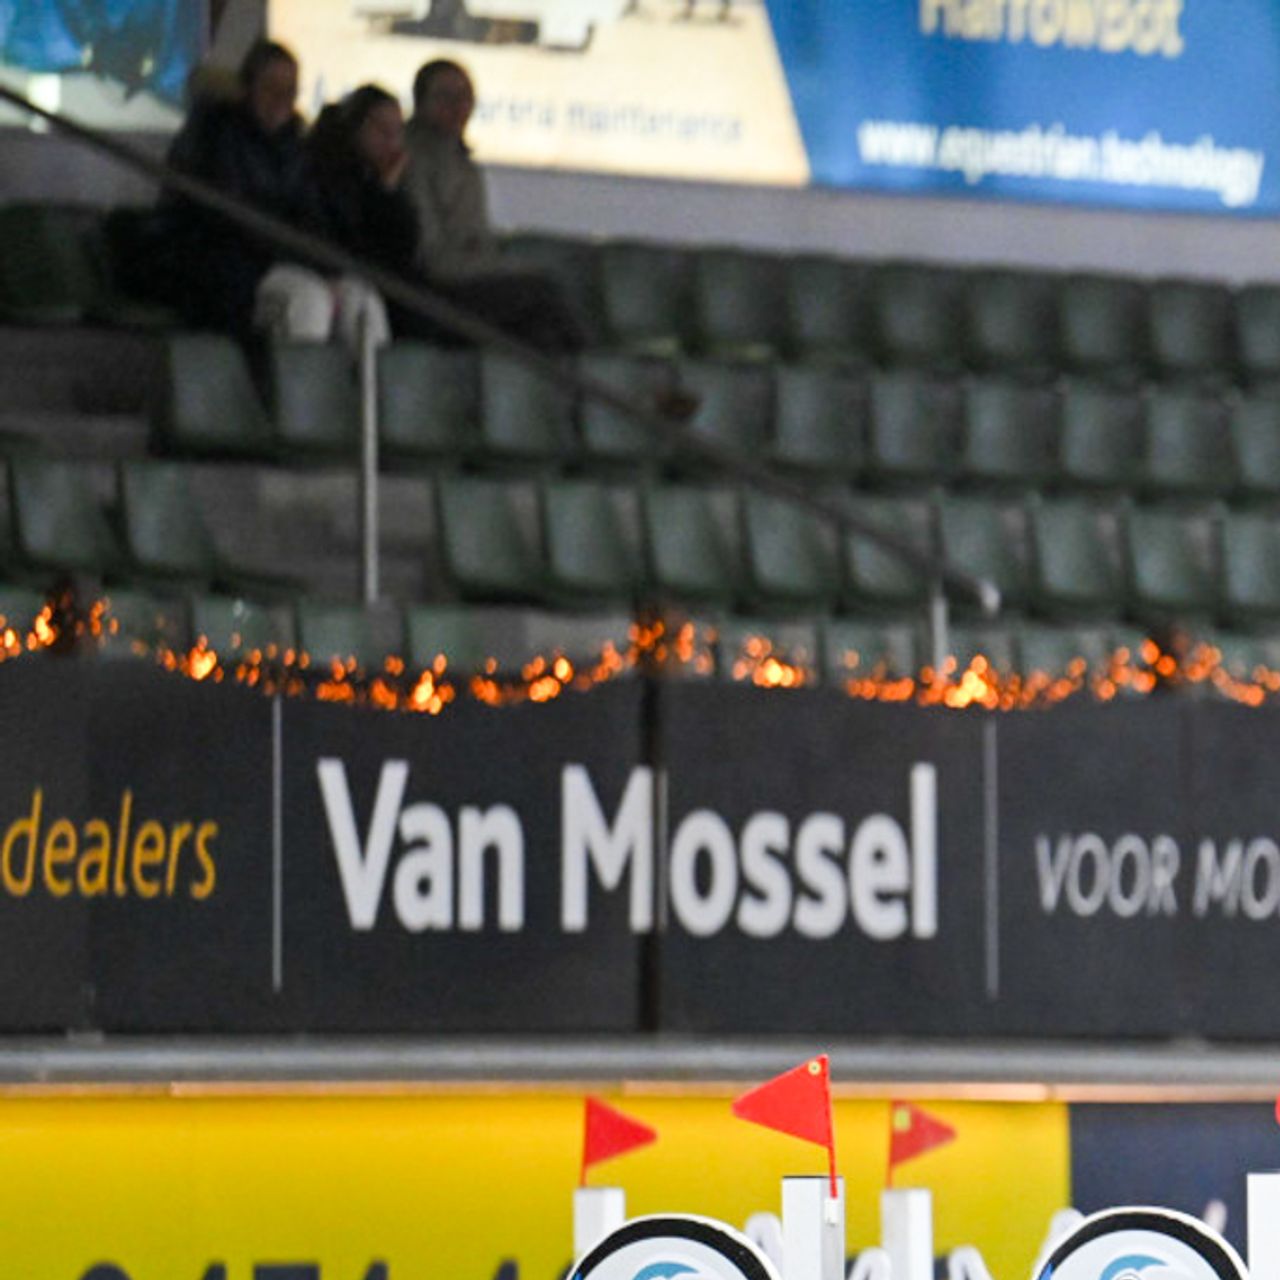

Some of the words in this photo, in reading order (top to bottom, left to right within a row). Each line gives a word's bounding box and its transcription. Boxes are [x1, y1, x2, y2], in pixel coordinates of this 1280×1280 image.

[1, 789, 217, 899] dealers
[318, 758, 524, 932] Van
[561, 762, 937, 938] Mossel
[1035, 833, 1181, 917] VOOR
